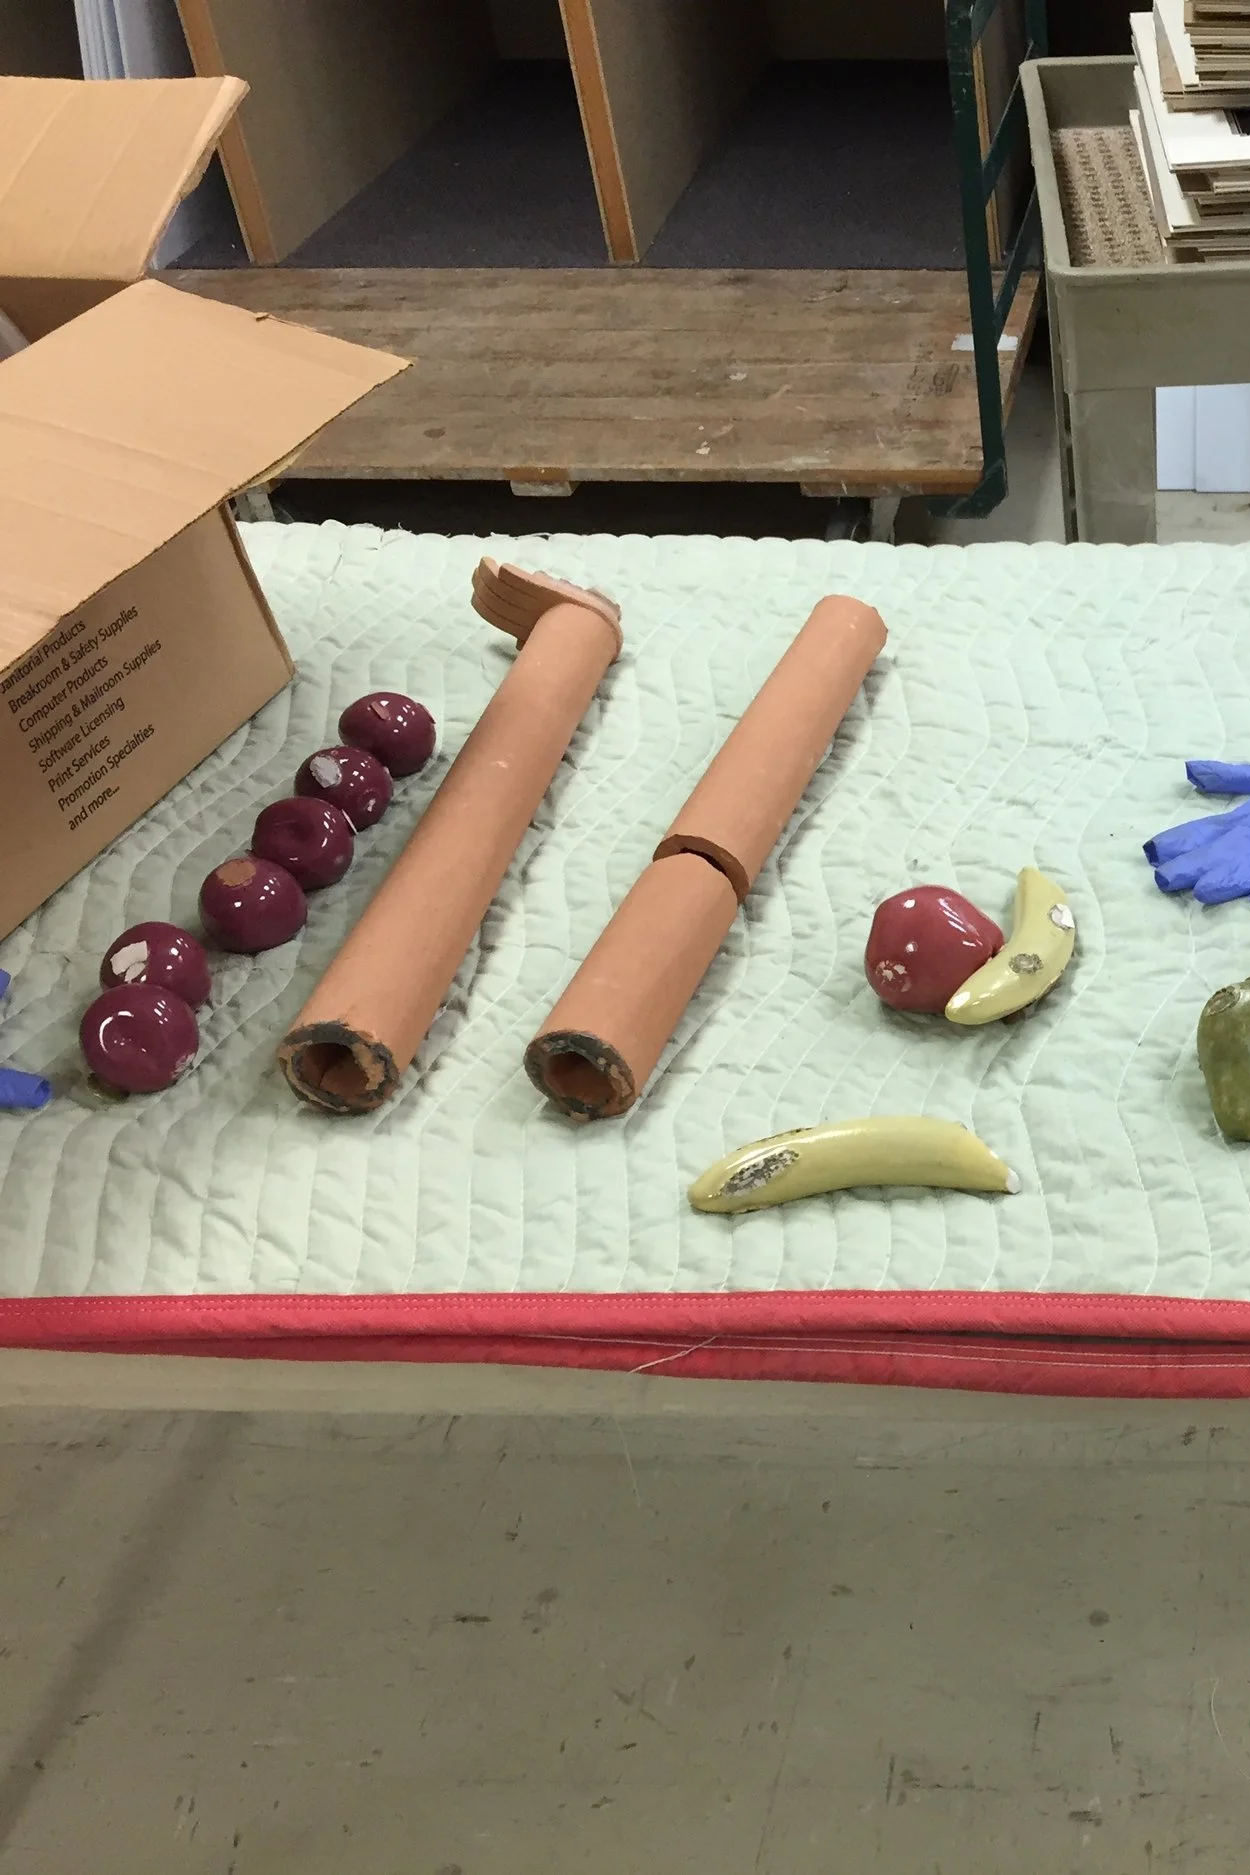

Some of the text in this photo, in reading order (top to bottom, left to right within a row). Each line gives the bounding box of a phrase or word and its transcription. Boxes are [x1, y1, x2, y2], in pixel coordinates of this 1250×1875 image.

[0, 620, 86, 694] Janitorial Products
[8, 606, 138, 714] Breakroom & Safety Supplies
[19, 656, 108, 733] Computer Products
[29, 639, 162, 754] Shipping & Mailroom Supplies
[39, 696, 126, 774] Software Licensing
[47, 735, 111, 793] Print Services
[57, 723, 155, 812] Promotion Specialties
[68, 785, 121, 831] and more...
